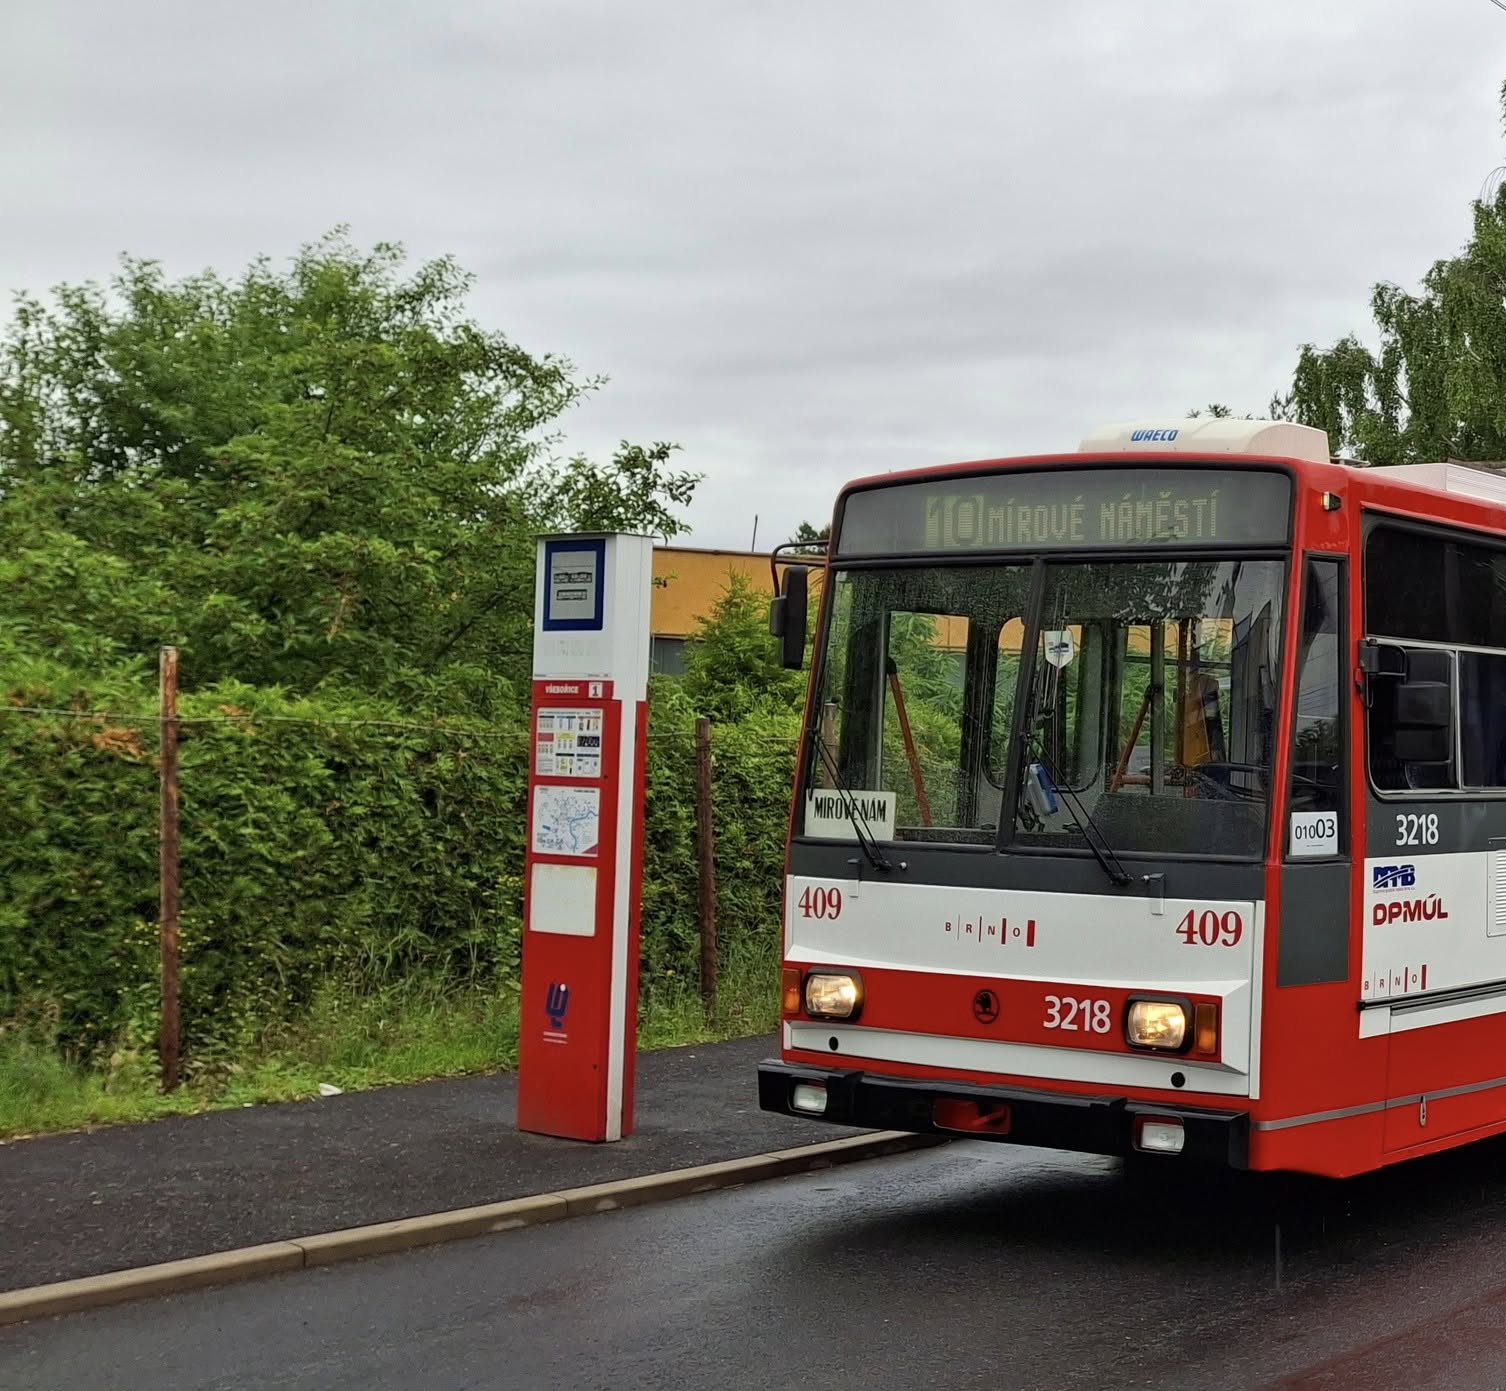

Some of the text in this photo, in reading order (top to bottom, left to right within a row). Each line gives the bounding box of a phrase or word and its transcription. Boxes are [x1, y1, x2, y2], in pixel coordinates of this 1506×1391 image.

[1131, 429, 1178, 441] WAECO
[988, 495, 1085, 543] MÍROVÉ
[1100, 489, 1220, 540] NÁMĚSTÍ
[1395, 813, 1440, 846] 3218
[798, 885, 842, 920] 409
[1373, 893, 1449, 926] DPMÚL
[1175, 909, 1243, 948] 409
[1042, 995, 1112, 1035] 3218
